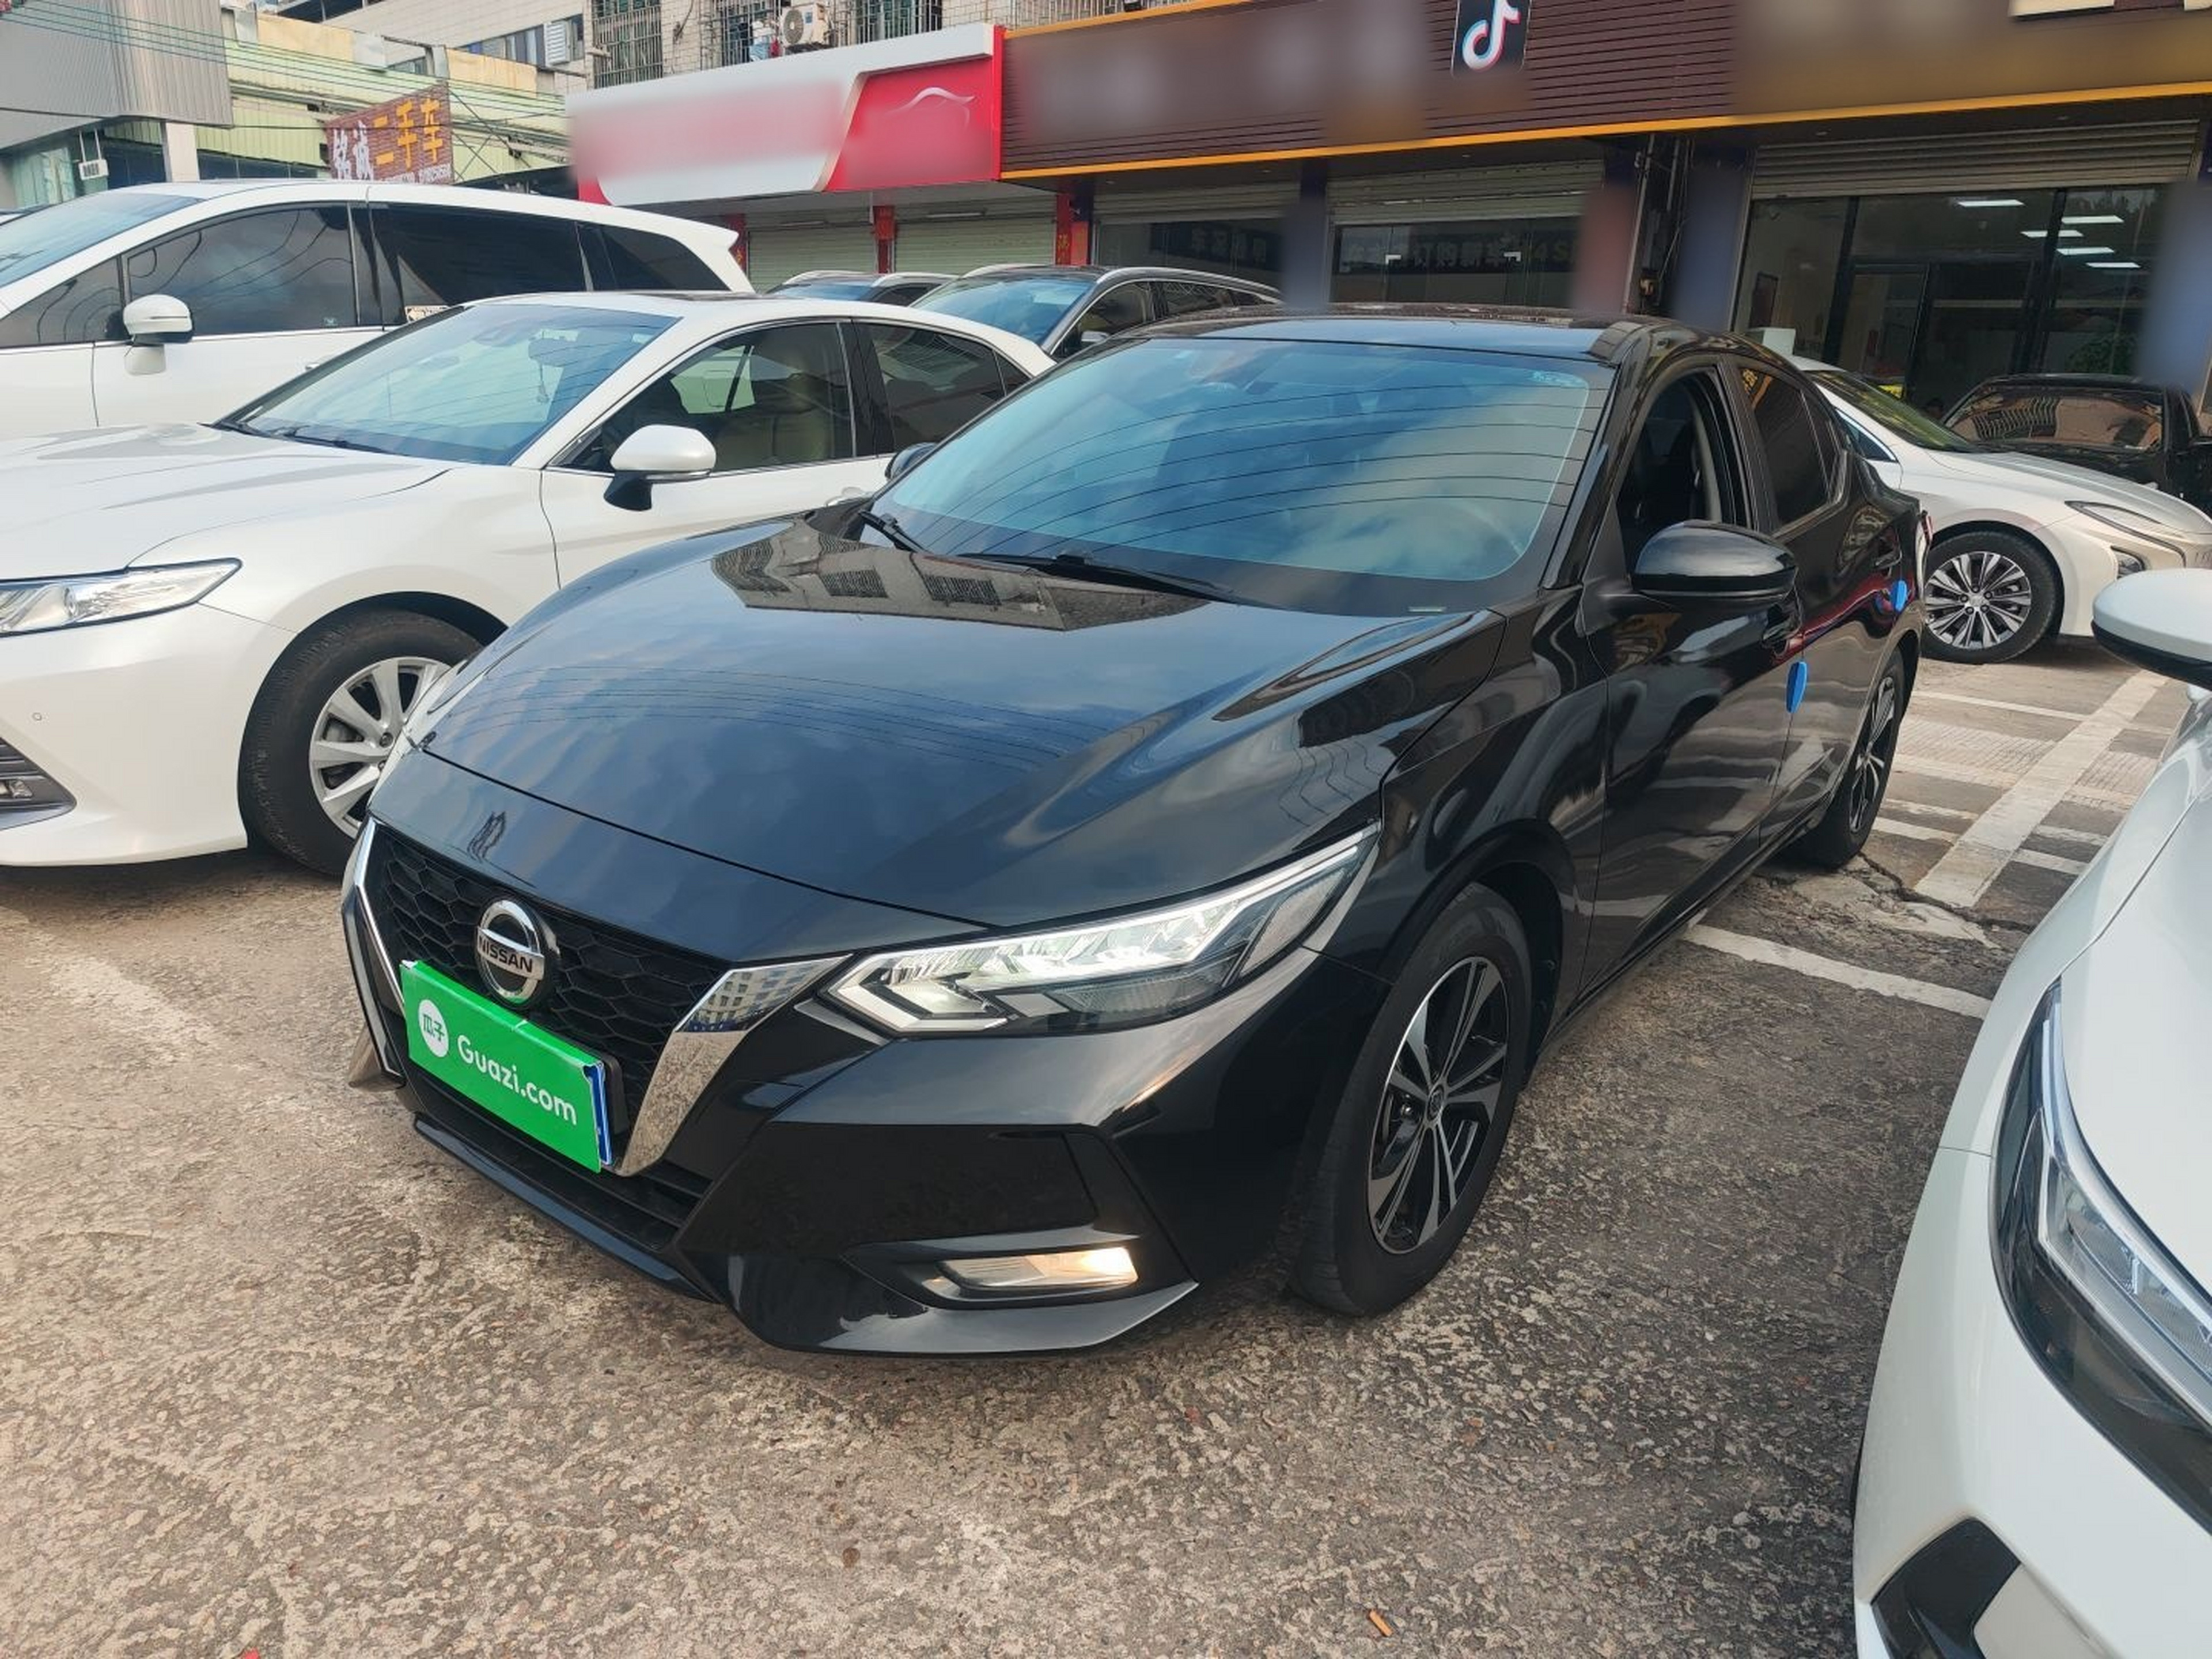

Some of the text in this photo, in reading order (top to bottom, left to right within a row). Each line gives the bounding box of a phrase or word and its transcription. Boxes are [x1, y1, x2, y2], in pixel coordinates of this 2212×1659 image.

[479, 936, 533, 973] NISSAN
[422, 1013, 445, 1042] 瓜子
[457, 1035, 578, 1126] Guazi.com
